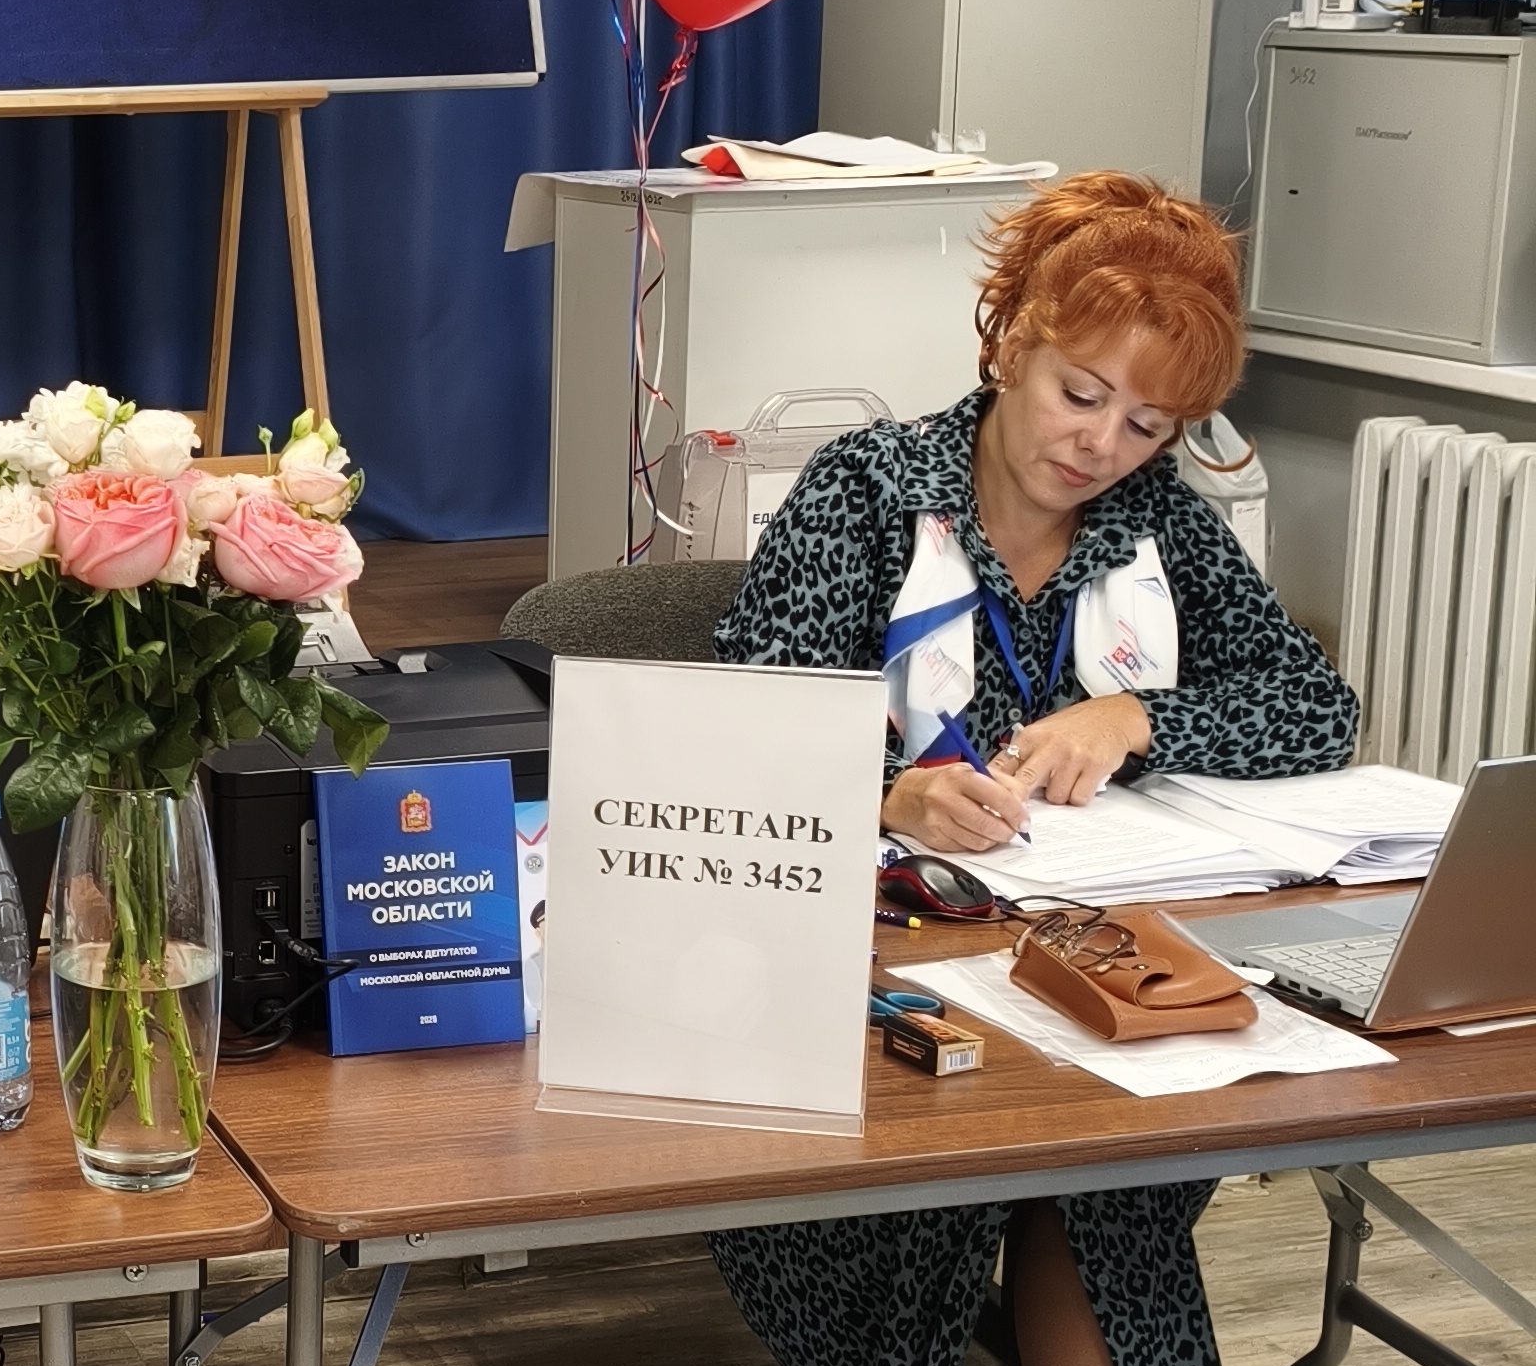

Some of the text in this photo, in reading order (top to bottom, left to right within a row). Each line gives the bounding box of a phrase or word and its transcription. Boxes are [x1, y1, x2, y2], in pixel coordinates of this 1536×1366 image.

[594, 798, 833, 843] СЕКРЕТАРЬ
[383, 852, 455, 873] ЗАКОН
[597, 848, 823, 893] УИК № 3452
[347, 869, 494, 901] МОСКОВСКОЙ
[371, 900, 472, 924] ОБЛАСТИ
[369, 946, 478, 963] О ВЫБОРАХ ДЕПУТАТОВ
[360, 966, 511, 986] МОСКОВСКОЙ ОБЛАСТНОЙ ДУМЫ
